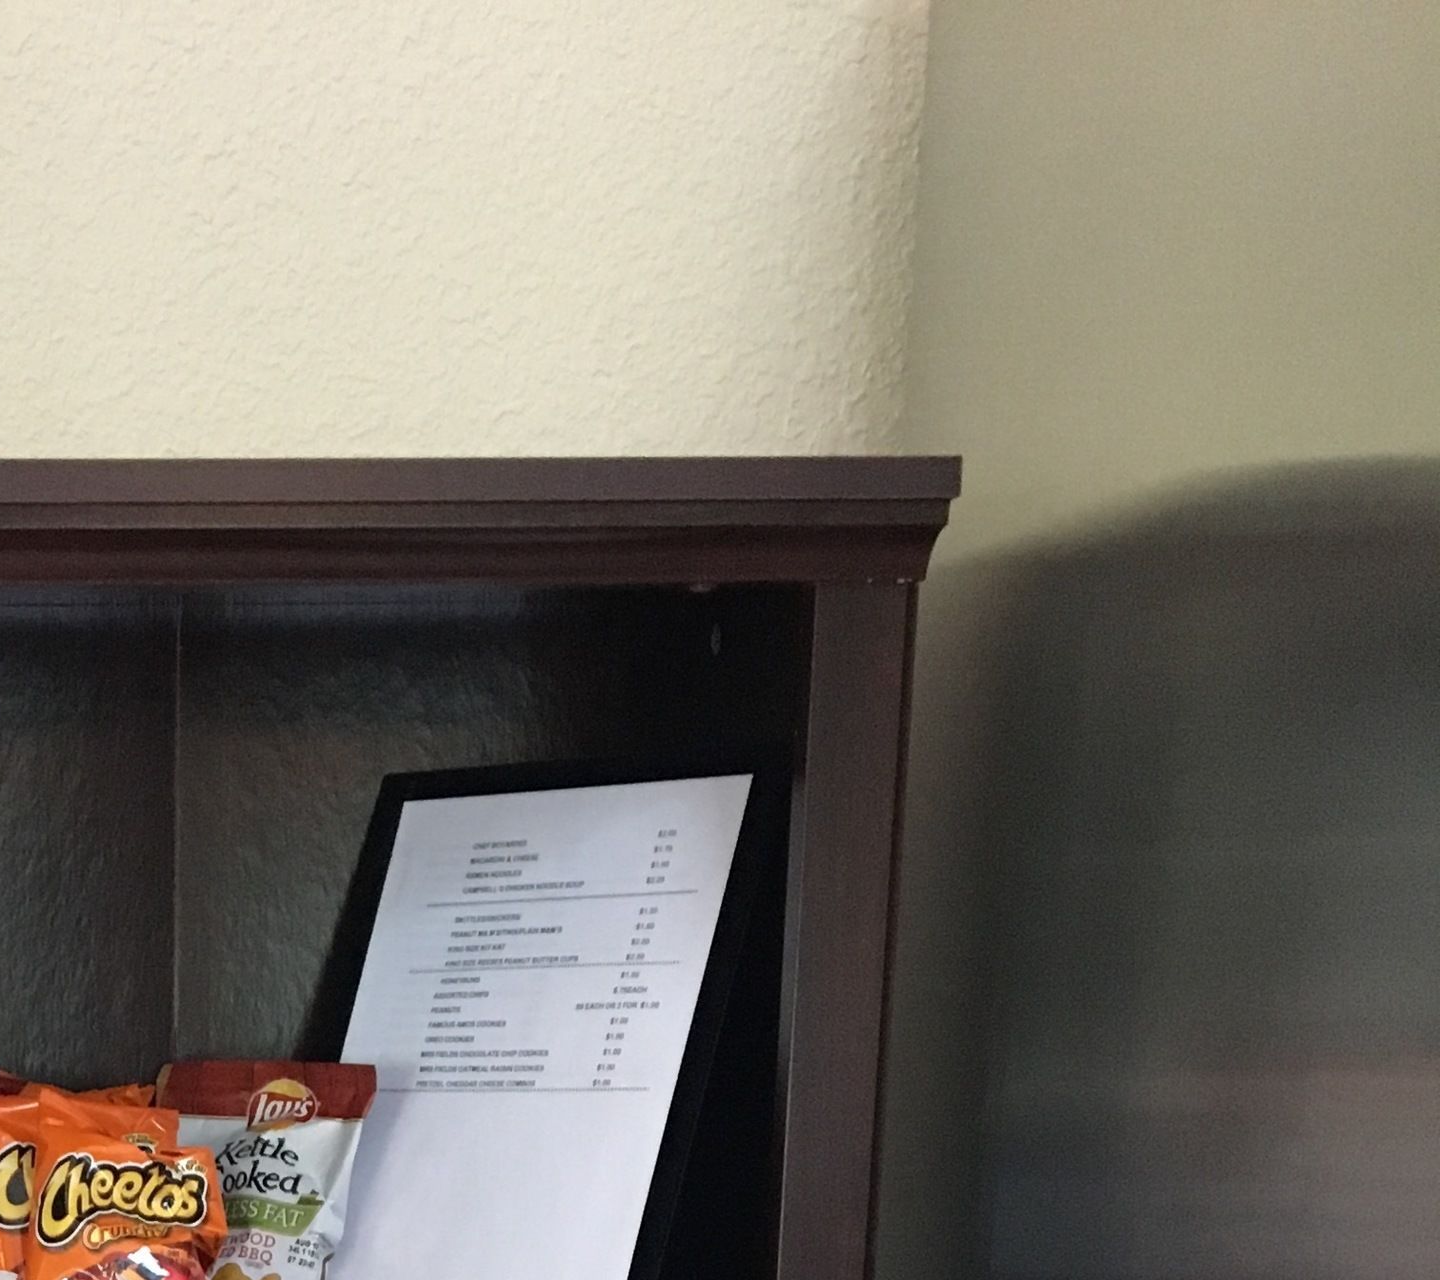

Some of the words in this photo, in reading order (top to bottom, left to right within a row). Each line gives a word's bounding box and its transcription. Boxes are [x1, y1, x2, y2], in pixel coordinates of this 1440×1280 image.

[217, 1135, 300, 1167] Kettle
[222, 1160, 302, 1195] ooked
[39, 1153, 203, 1245] Cheetos
[263, 1203, 304, 1228] FAT
[238, 1246, 273, 1266] BBQ
